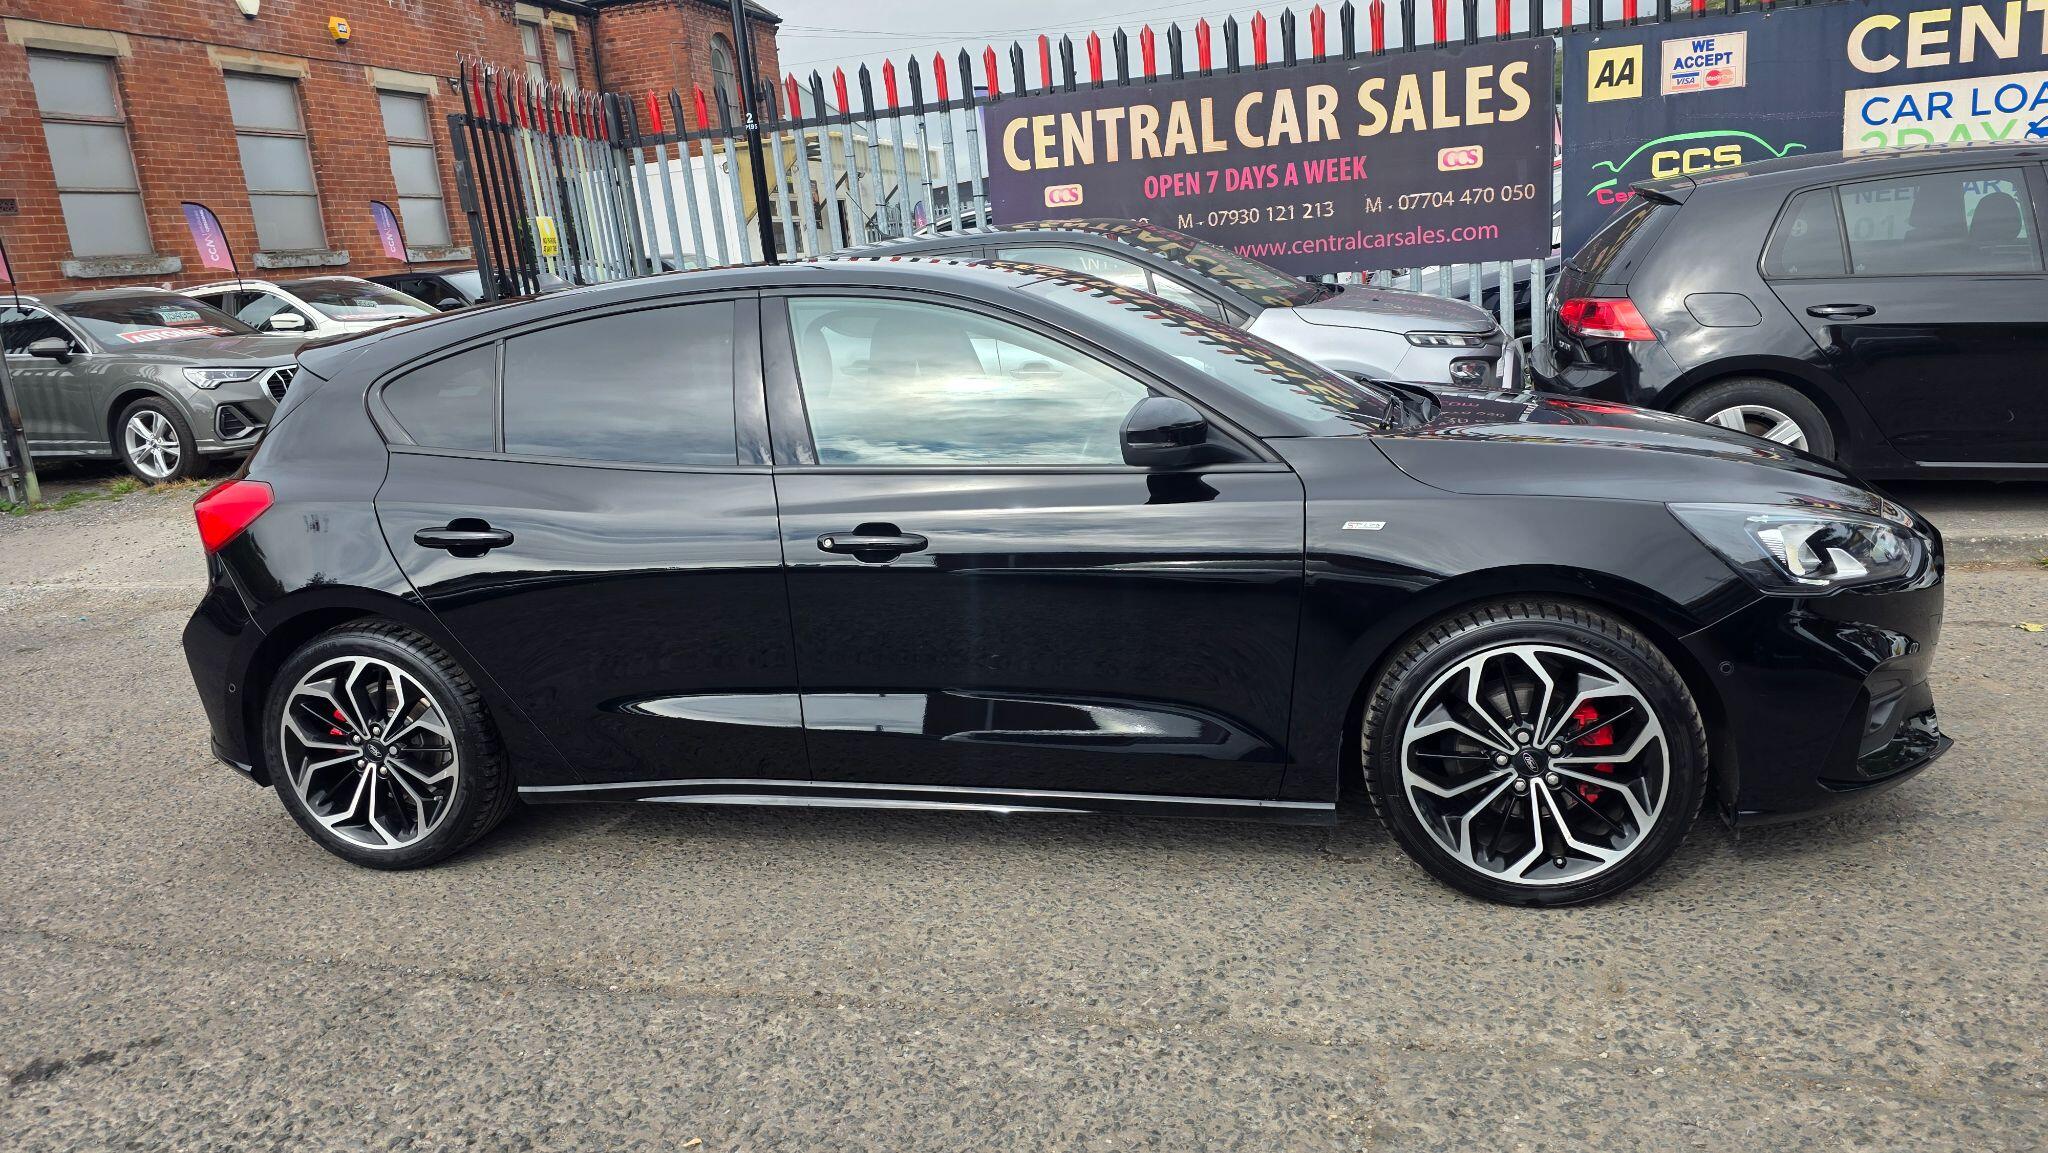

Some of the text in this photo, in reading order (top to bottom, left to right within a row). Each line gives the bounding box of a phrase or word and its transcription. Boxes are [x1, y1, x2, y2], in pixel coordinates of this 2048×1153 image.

[1692, 39, 1715, 53] WE
[1594, 57, 1635, 89] AA
[1673, 52, 1734, 71] ACCEPT
[1676, 77, 1695, 86] VISA
[746, 112, 754, 124] 2
[1003, 61, 1531, 172] CENTRAL CAR SALES
[1861, 91, 1954, 126] CAR
[1652, 144, 1742, 180] CCS
[1144, 155, 1368, 200] OPEN 7 DAYS A WEEK
[1398, 191, 1455, 211] 07704
[1460, 187, 1494, 205] 470
[1501, 183, 1536, 202] 050
[1207, 207, 1260, 227] 07930
[1266, 204, 1294, 222] 121
[1302, 200, 1335, 219] 213
[1234, 224, 1499, 258] www.centralcarsales.com
